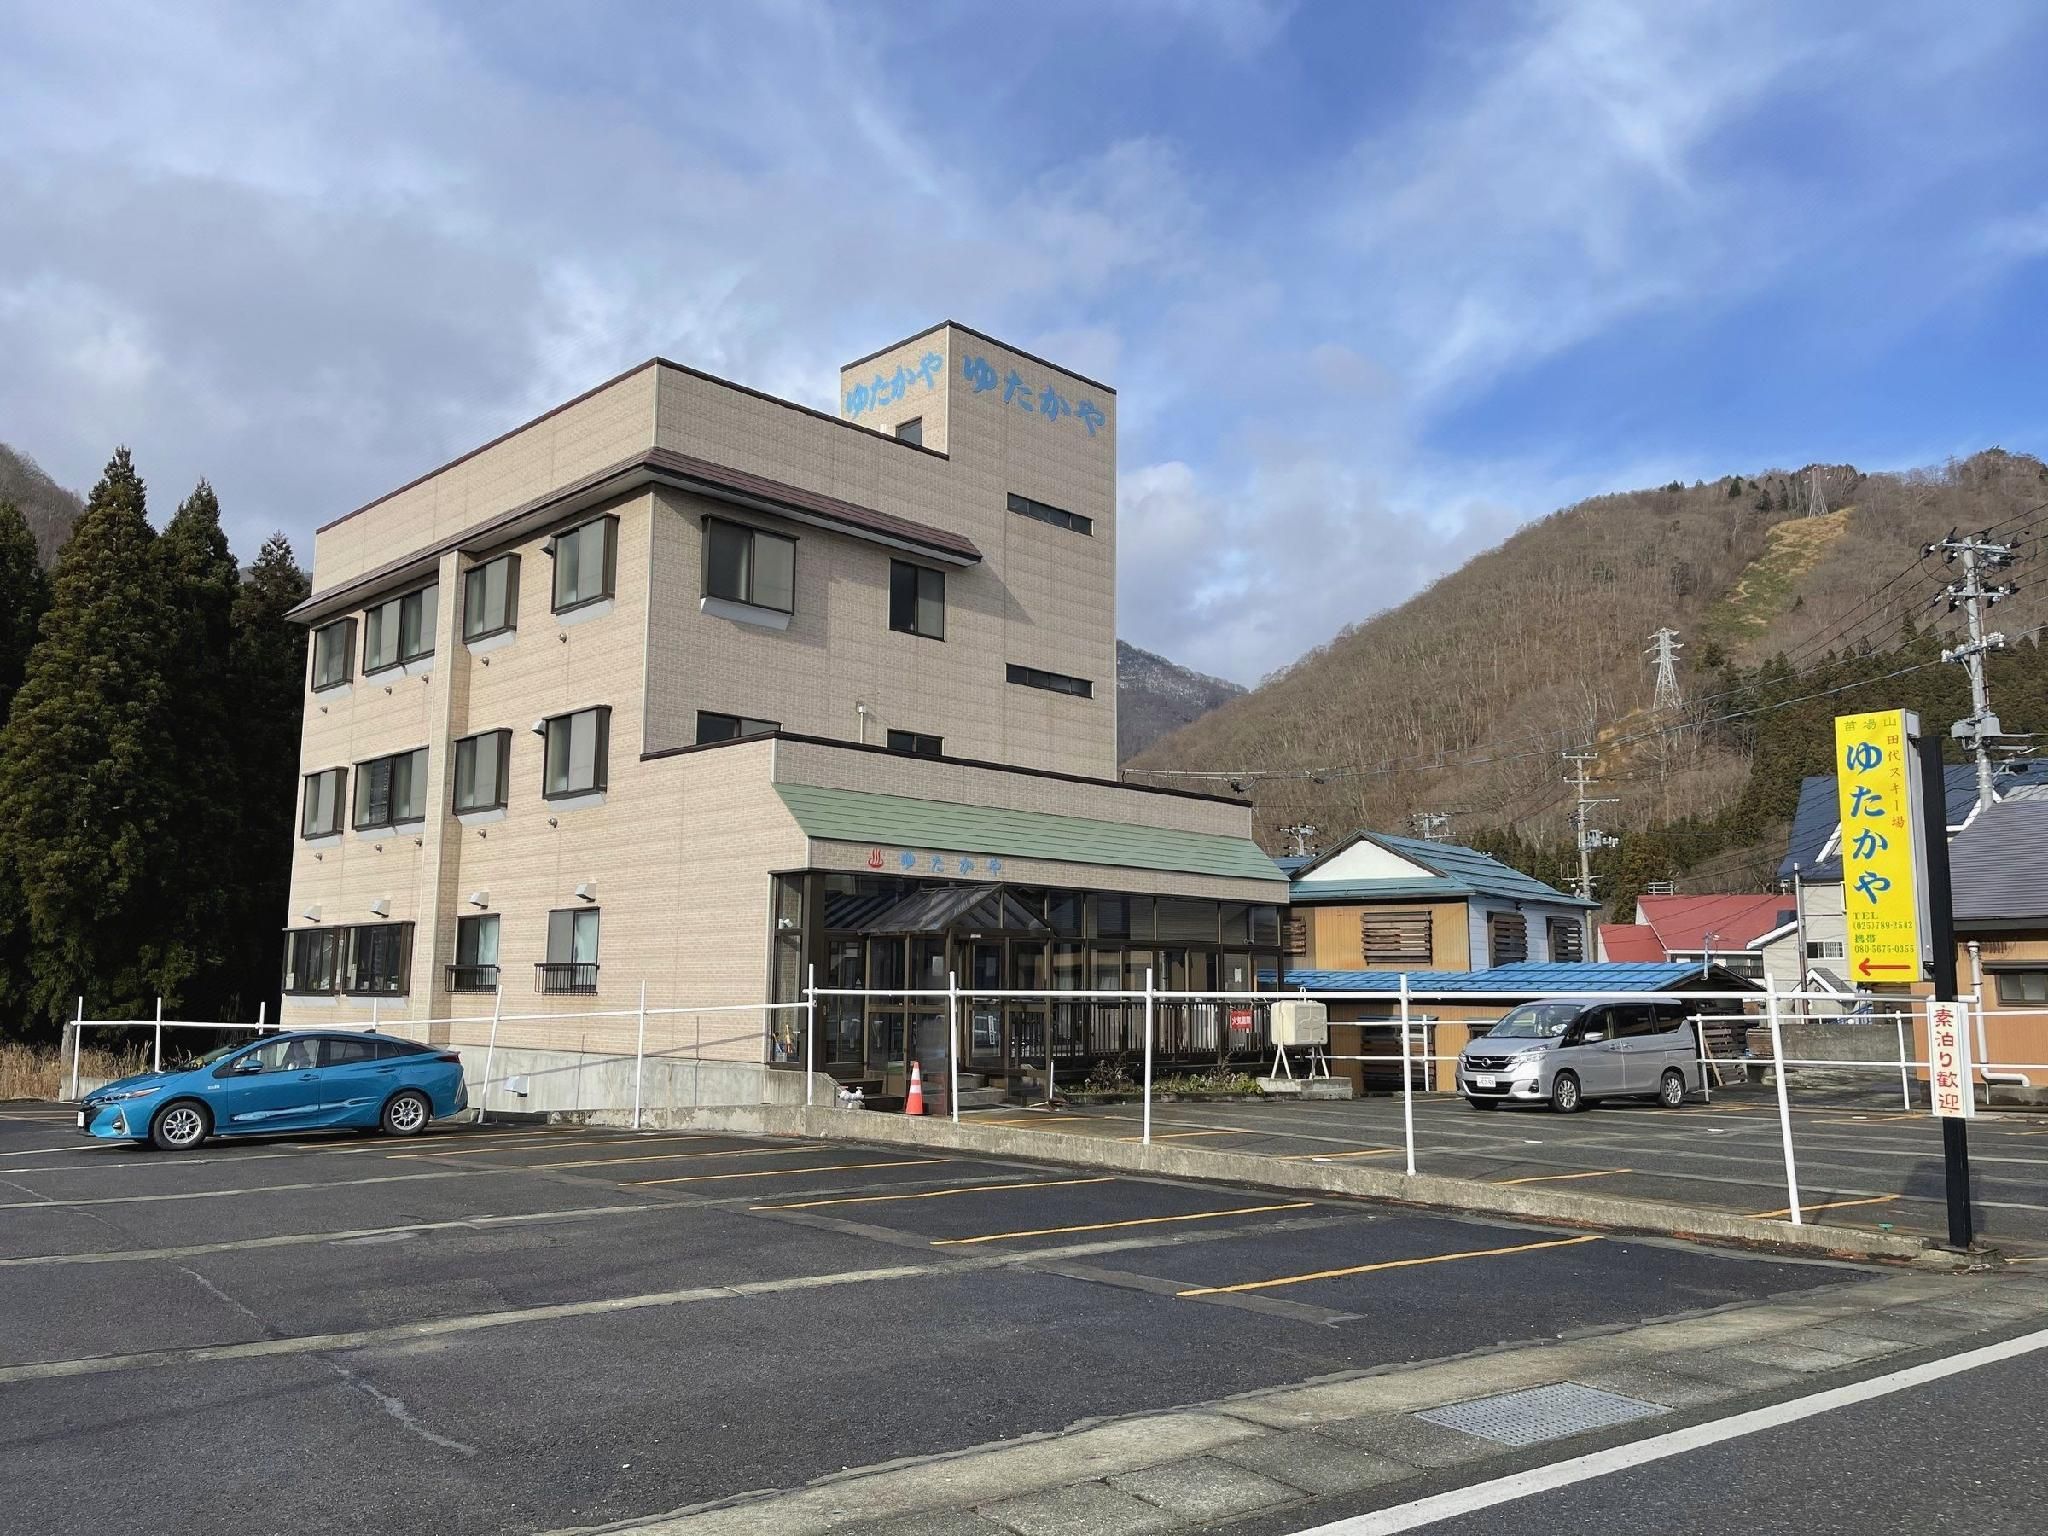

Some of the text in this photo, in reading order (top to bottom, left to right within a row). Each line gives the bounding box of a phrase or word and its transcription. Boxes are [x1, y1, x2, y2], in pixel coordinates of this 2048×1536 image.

[846, 351, 944, 420] ゆたかや
[963, 354, 1106, 437] ゆたかや
[1846, 741, 1891, 905] ゆたかや
[1887, 734, 1905, 829] 田代スキー場
[899, 848, 1002, 877] ゆたかや
[1853, 911, 1879, 920] TEL
[1934, 1008, 1960, 1111] 素泊り歓迎
